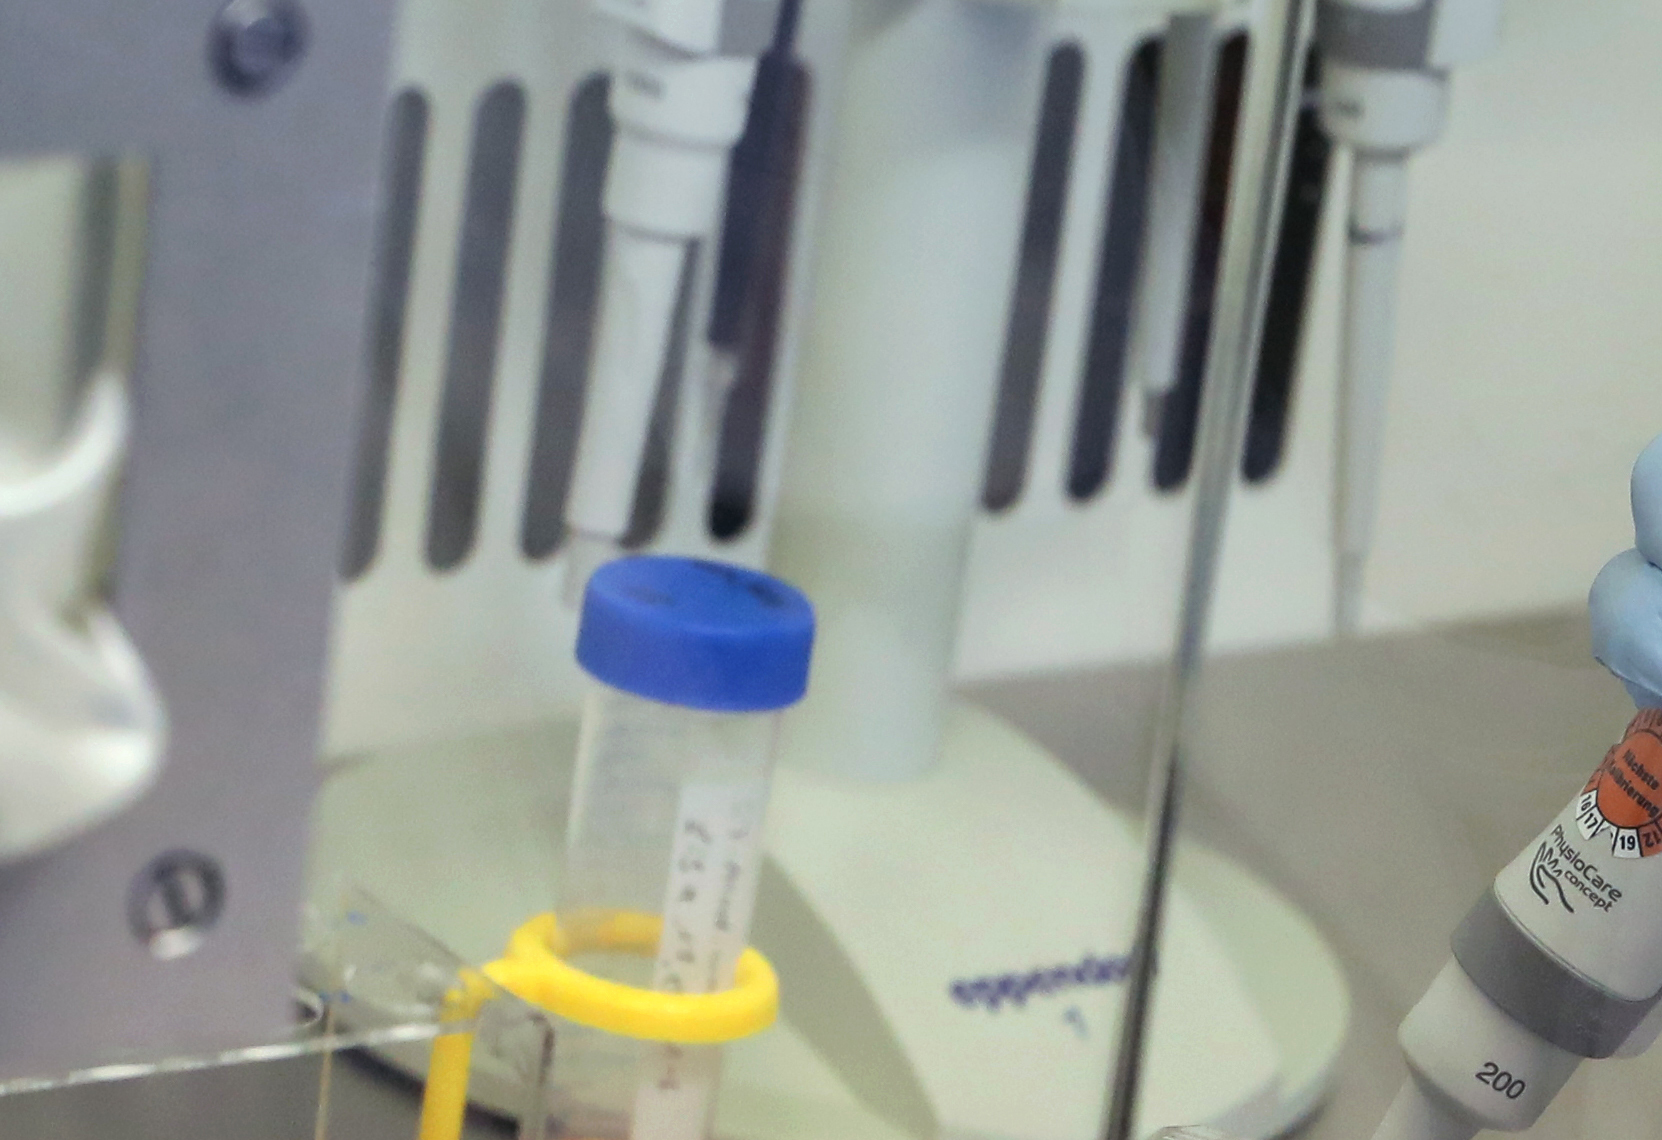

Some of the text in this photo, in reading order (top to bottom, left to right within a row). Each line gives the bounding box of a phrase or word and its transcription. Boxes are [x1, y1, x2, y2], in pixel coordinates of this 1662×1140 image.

[1583, 812, 1599, 830] 17
[1619, 835, 1636, 851] 19
[1551, 823, 1623, 903] PhysioCare
[1564, 870, 1614, 913] concept
[1475, 1061, 1526, 1099] 200
